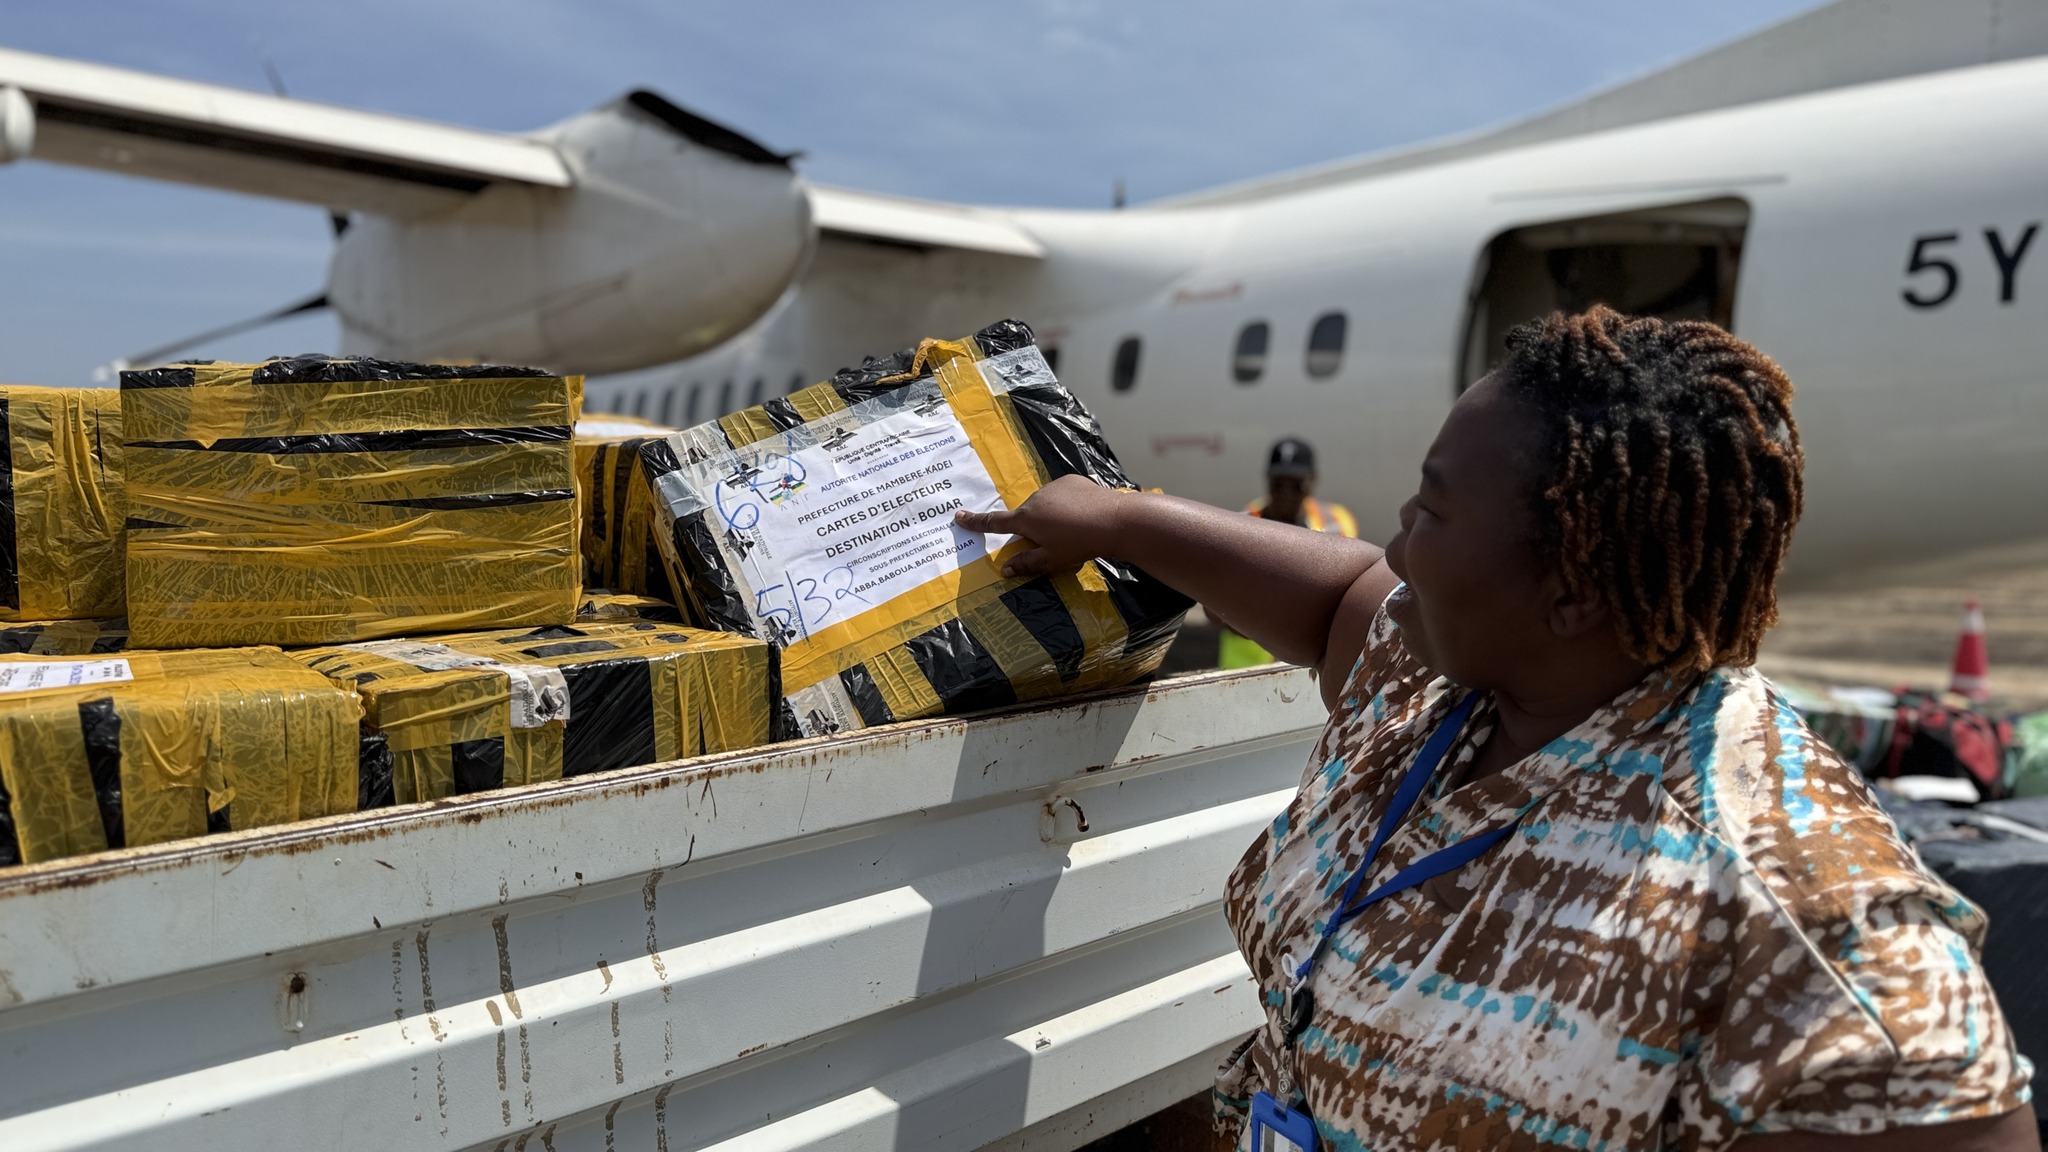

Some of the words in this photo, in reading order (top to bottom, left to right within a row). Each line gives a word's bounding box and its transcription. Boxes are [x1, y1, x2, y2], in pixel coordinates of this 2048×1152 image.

[1902, 224, 2039, 308] 5Y
[819, 473, 857, 493] AUTORITE
[857, 456, 900, 478] NATIONALE
[899, 450, 915, 462] DES
[915, 435, 956, 456] ELECTIONS
[830, 446, 865, 464] EPUBLIQUE
[797, 493, 860, 525] PREFECTURE
[860, 487, 875, 499] DE
[875, 458, 953, 494] MAMBERE-KADEI
[815, 510, 867, 537] CARTES
[824, 517, 910, 558] DESTINATION
[917, 497, 963, 522] BOUAR
[845, 537, 911, 568] CIRCONSCRIPTIONS
[867, 540, 935, 573] SOUS-PREFECTURES
[934, 537, 944, 545] DE
